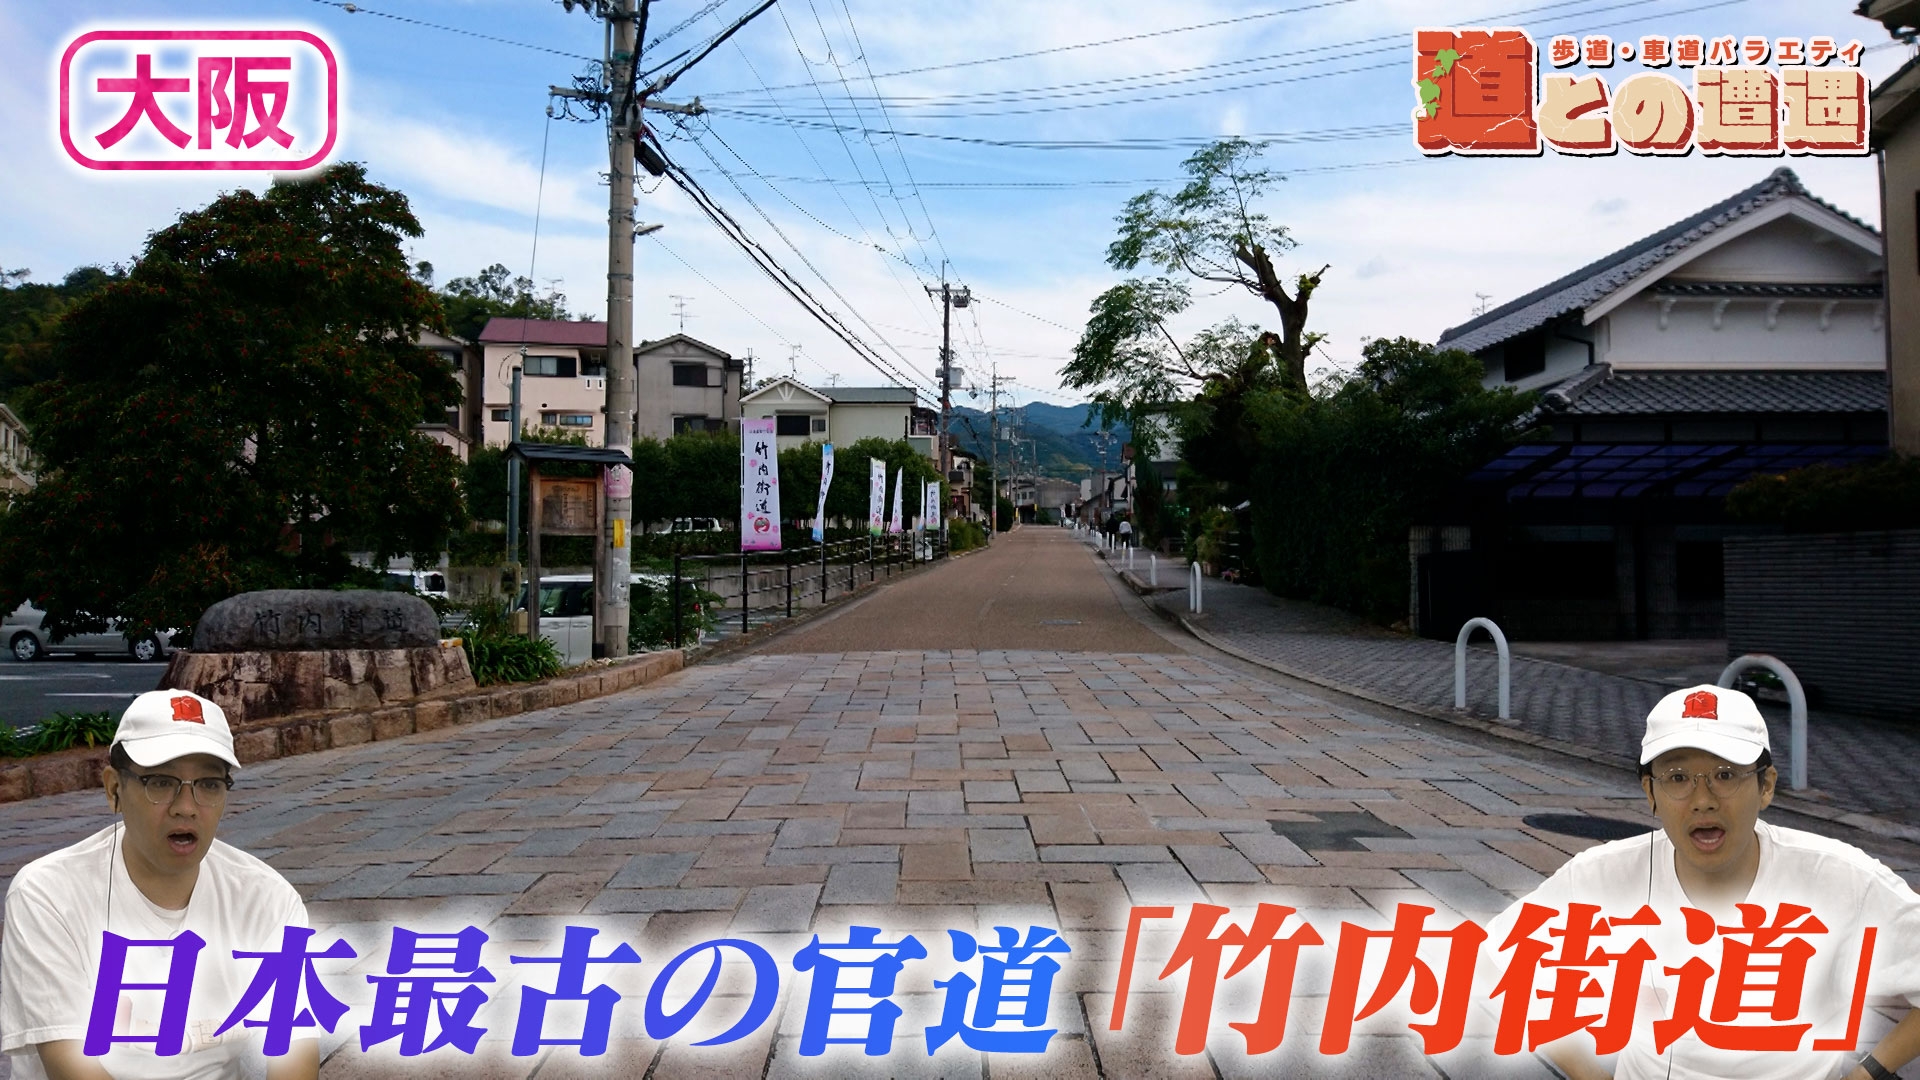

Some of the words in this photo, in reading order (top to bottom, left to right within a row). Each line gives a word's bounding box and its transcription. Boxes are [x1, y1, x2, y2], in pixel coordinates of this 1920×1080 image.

[754, 441, 772, 515] 竹内街道
[253, 608, 409, 637] 竹内街道
